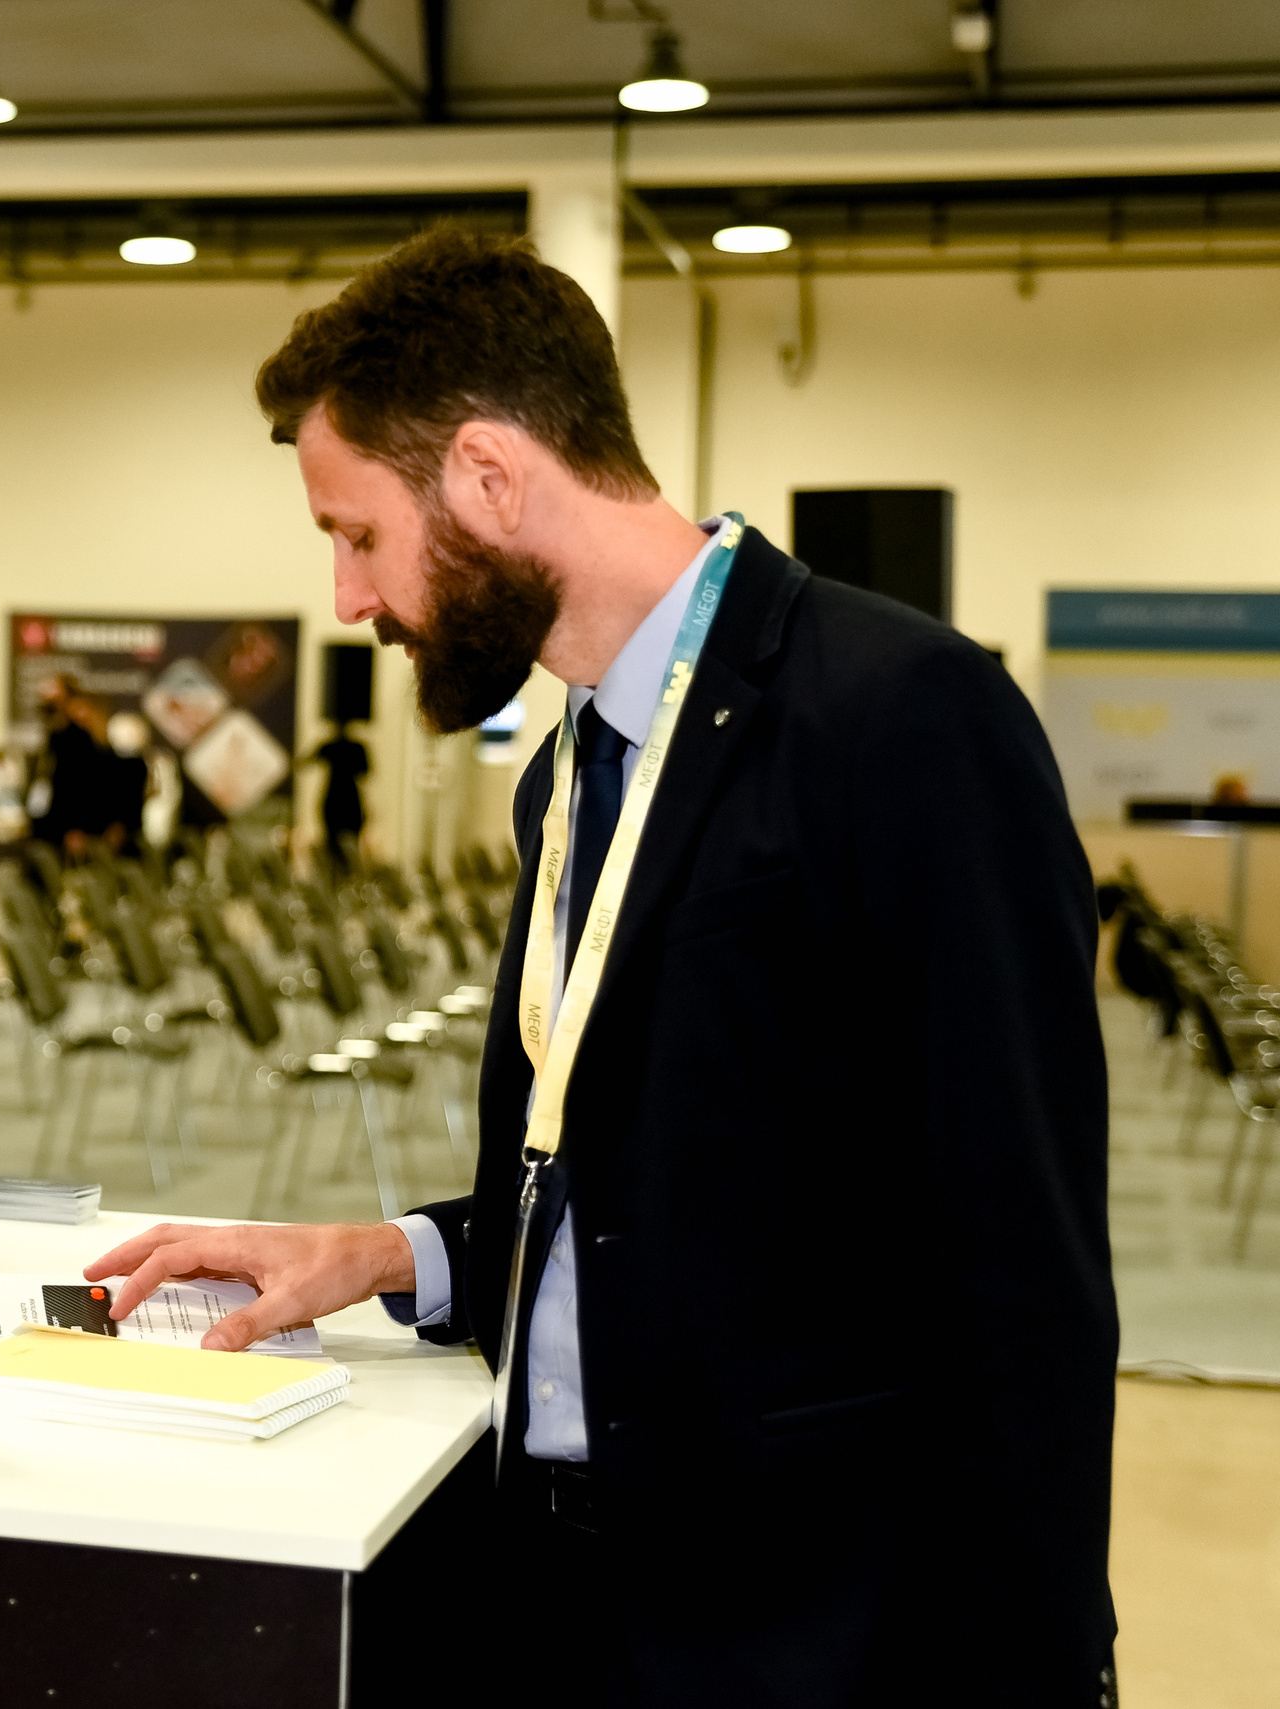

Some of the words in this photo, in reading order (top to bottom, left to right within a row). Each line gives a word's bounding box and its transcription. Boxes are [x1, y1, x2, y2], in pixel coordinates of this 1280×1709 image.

[694, 578, 720, 629] МЕФТ
[638, 740, 665, 788] МЕФТ
[589, 904, 614, 953] МЕФТ
[527, 1002, 541, 1048] МЕФТ
